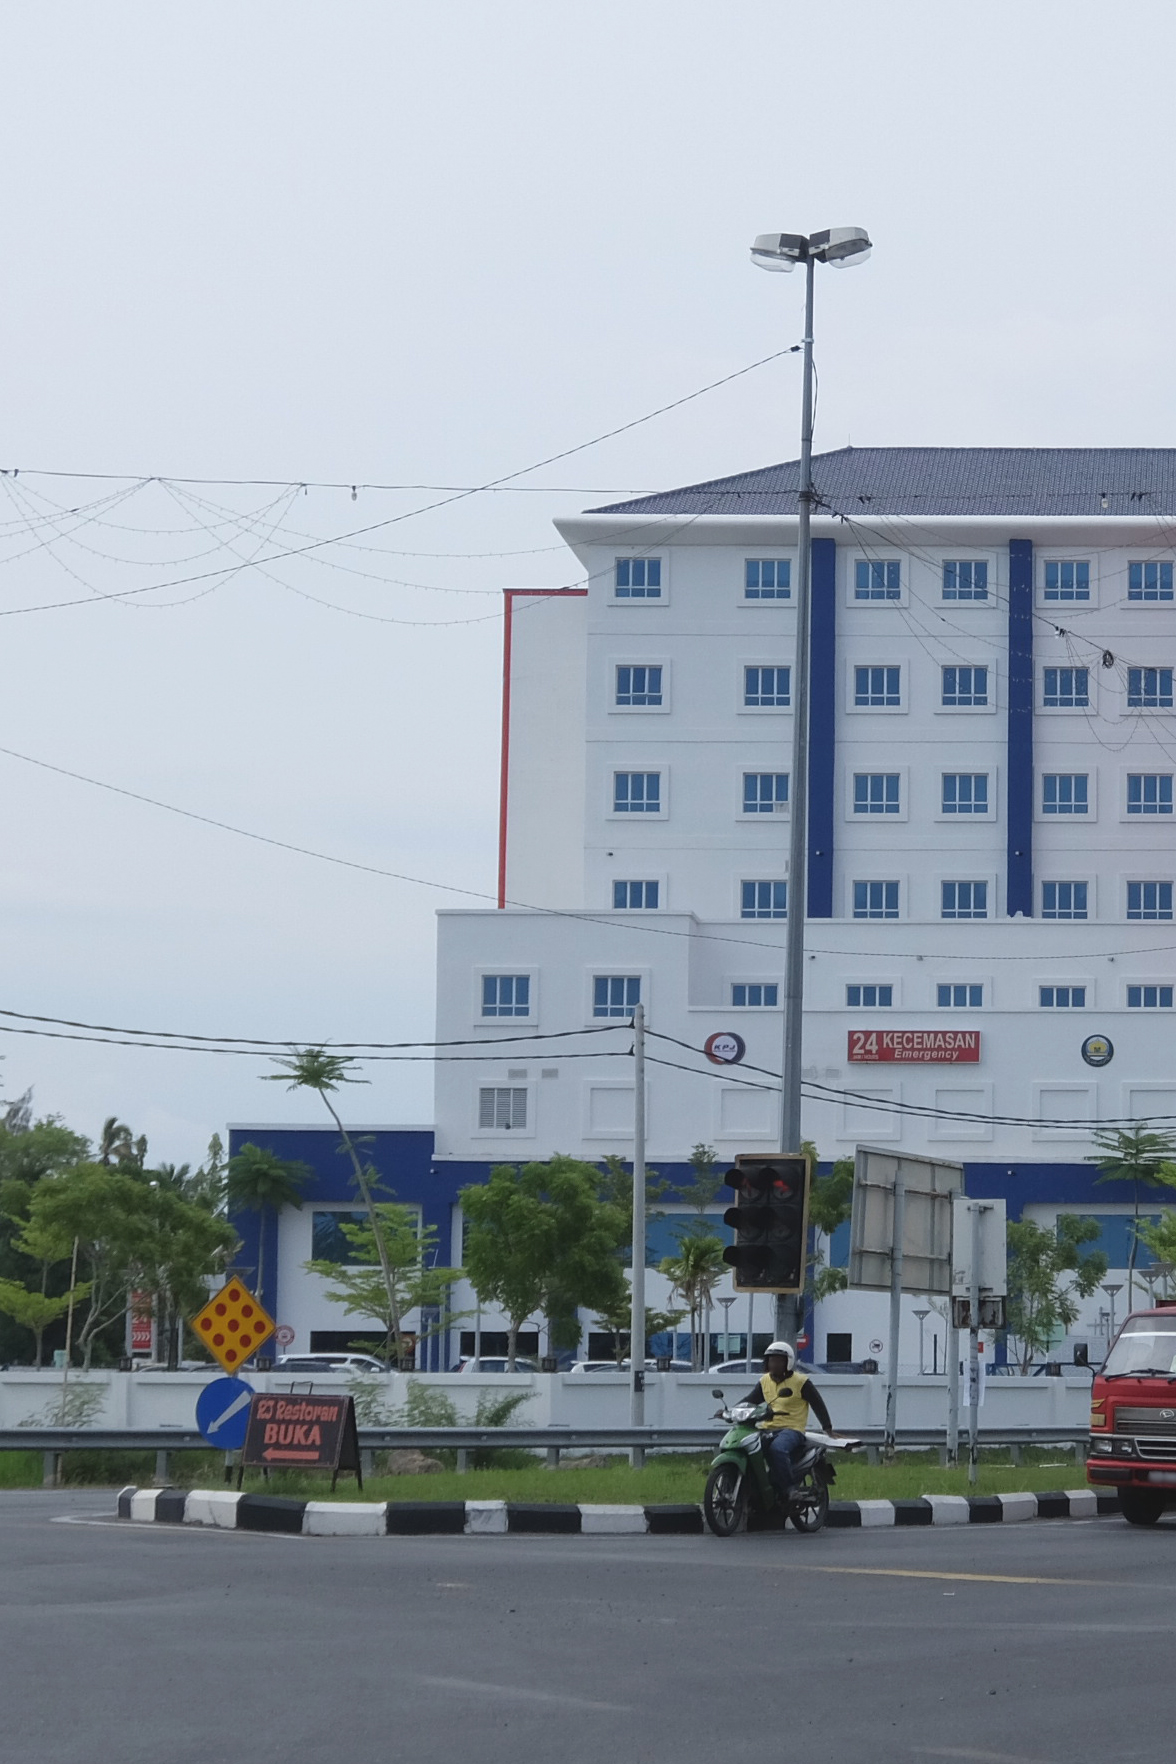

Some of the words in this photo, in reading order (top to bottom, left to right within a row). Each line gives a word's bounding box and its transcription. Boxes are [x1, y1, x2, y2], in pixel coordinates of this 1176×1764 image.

[852, 1032, 879, 1054] 24
[883, 1033, 975, 1049] KECEMASAN
[894, 1049, 959, 1060] Emergency
[276, 1401, 339, 1422] Restoran
[264, 1424, 321, 1446] BUKA
